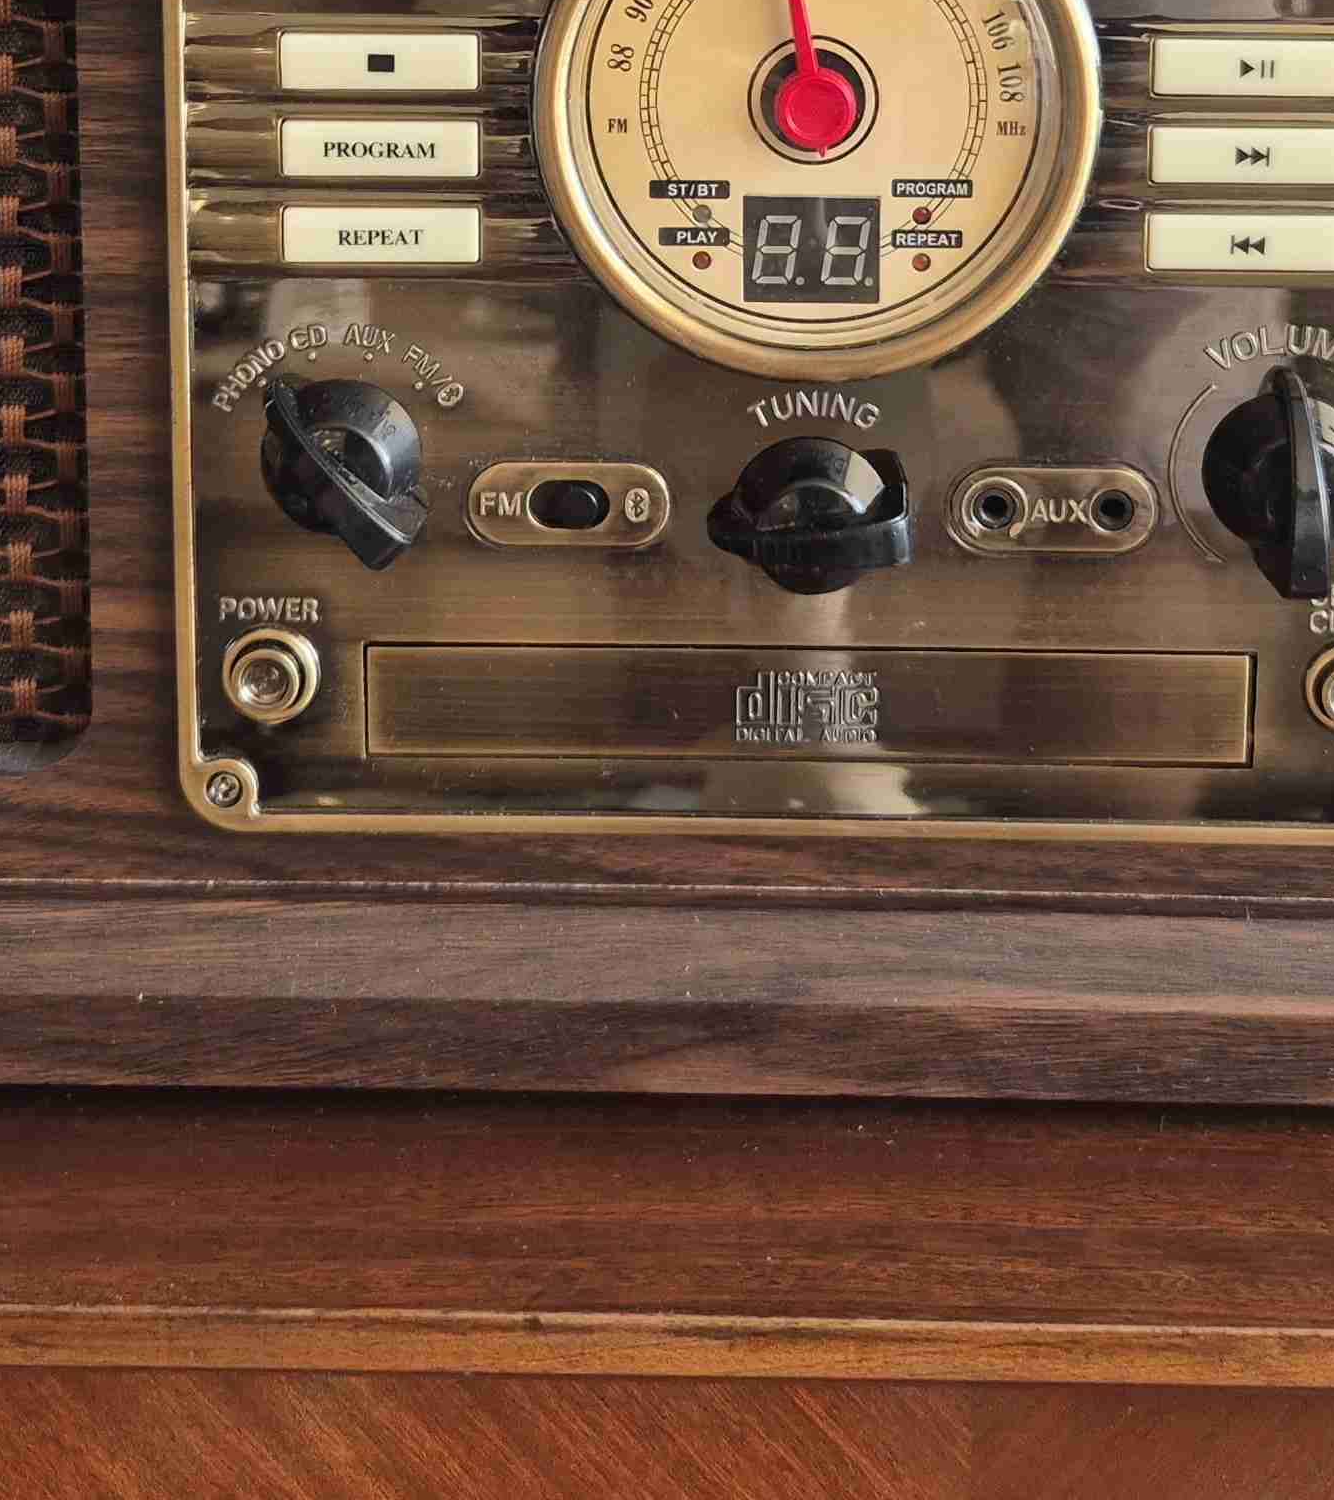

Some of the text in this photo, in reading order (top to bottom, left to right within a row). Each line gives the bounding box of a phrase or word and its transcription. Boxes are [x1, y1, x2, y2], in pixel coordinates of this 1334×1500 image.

[981, 9, 1014, 52] 106
[607, 43, 636, 72] 88
[997, 63, 1024, 102] 108
[607, 118, 628, 134] FM
[995, 120, 1027, 137] MHz
[322, 140, 436, 160] PROGRAM
[667, 182, 718, 198] ST/BT
[896, 181, 968, 197] PROGRAM
[338, 229, 424, 246] REPEAT
[675, 229, 718, 245] PLAY
[896, 231, 958, 248] REPEAT
[211, 338, 287, 413] PHONO
[287, 323, 328, 351] CD
[344, 323, 396, 354] AUX
[746, 389, 882, 430] TUNING
[478, 492, 525, 517] FM
[1028, 499, 1093, 524] AUX
[218, 597, 320, 622] POWER
[777, 670, 878, 686] COMPACT
[820, 727, 877, 741] AUDIO
